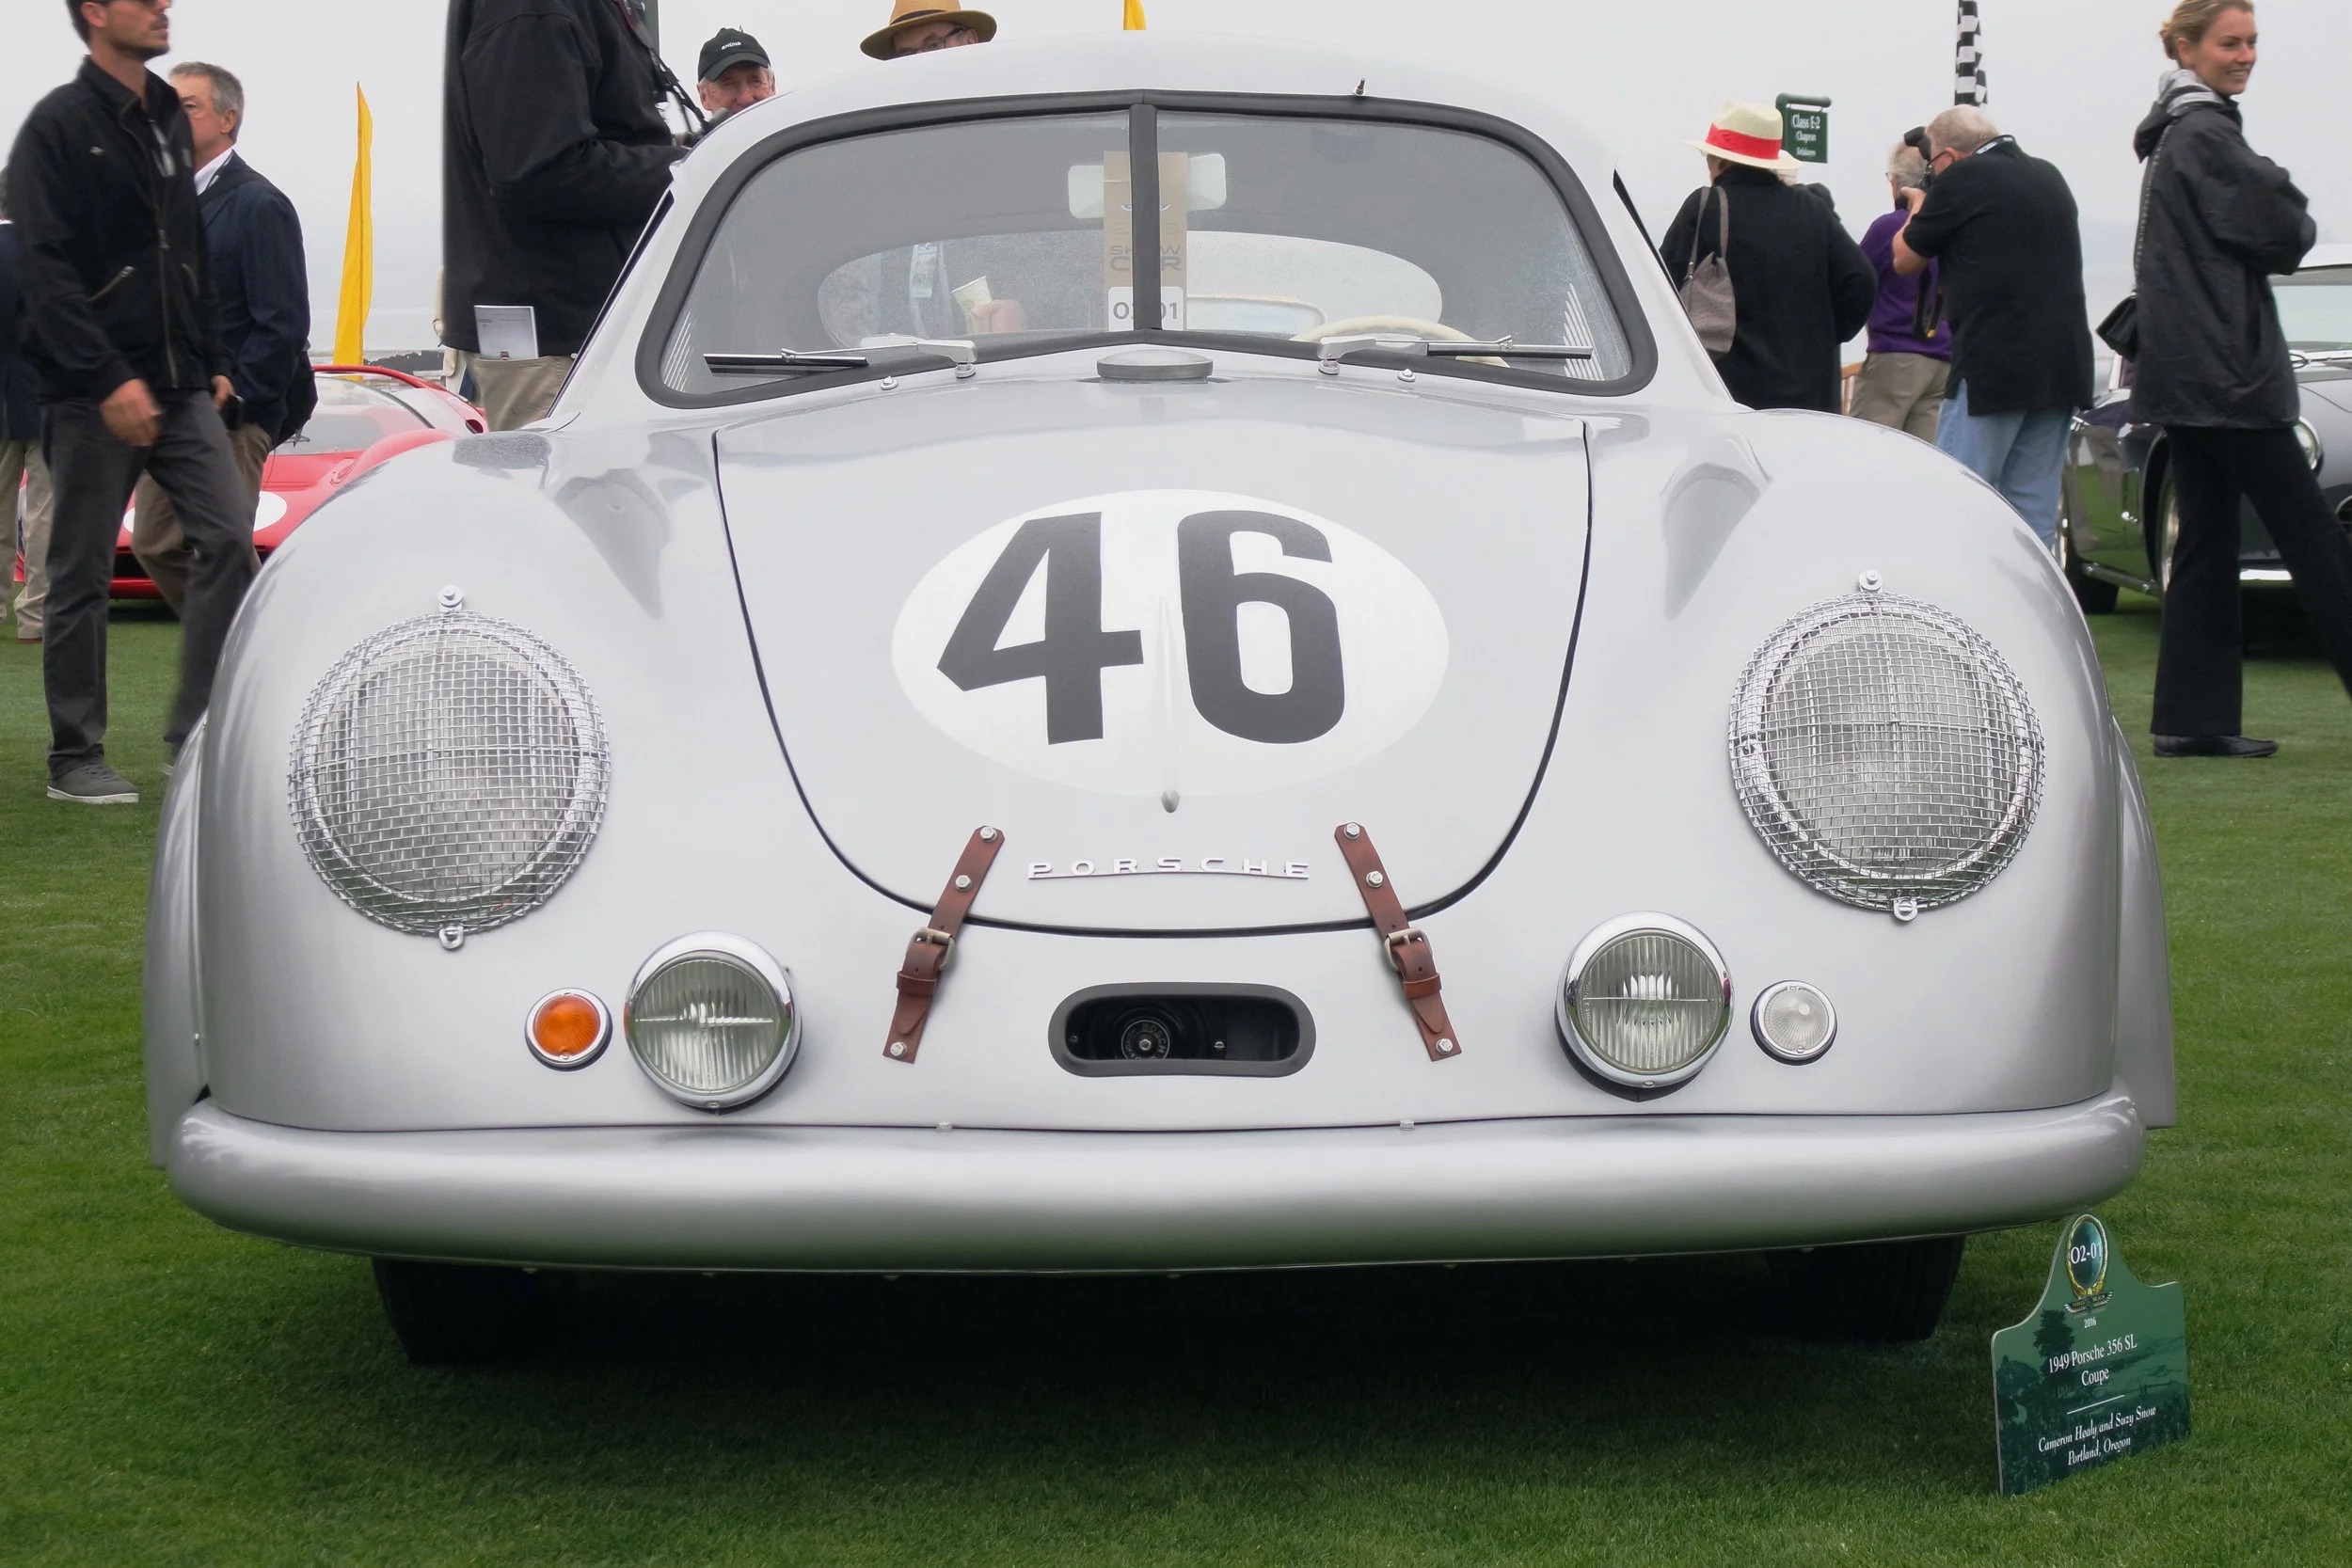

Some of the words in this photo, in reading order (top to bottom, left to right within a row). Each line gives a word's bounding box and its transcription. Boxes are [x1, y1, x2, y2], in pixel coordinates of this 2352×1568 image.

[1792, 114, 1809, 128] Class
[1110, 245, 1182, 256] SHW
[1110, 256, 1182, 272] CR
[936, 510, 1345, 745] 46
[1028, 857, 1309, 879] PORSCHE
[2084, 1316, 2097, 1328] 2016
[2048, 1354, 2070, 1373] 1949
[2072, 1344, 2105, 1366] Porsche
[2106, 1337, 2123, 1355] 356
[2124, 1334, 2137, 1351] SL
[2081, 1368, 2109, 1386] Coupe
[2038, 1437, 2073, 1452] Cameron
[2074, 1418, 2097, 1440] Healy
[2099, 1412, 2113, 1433] and
[2115, 1412, 2134, 1427] Suzy
[2136, 1405, 2156, 1420] Snow
[2067, 1439, 2102, 1465] Portland,
[2103, 1437, 2131, 1452] Oregon
